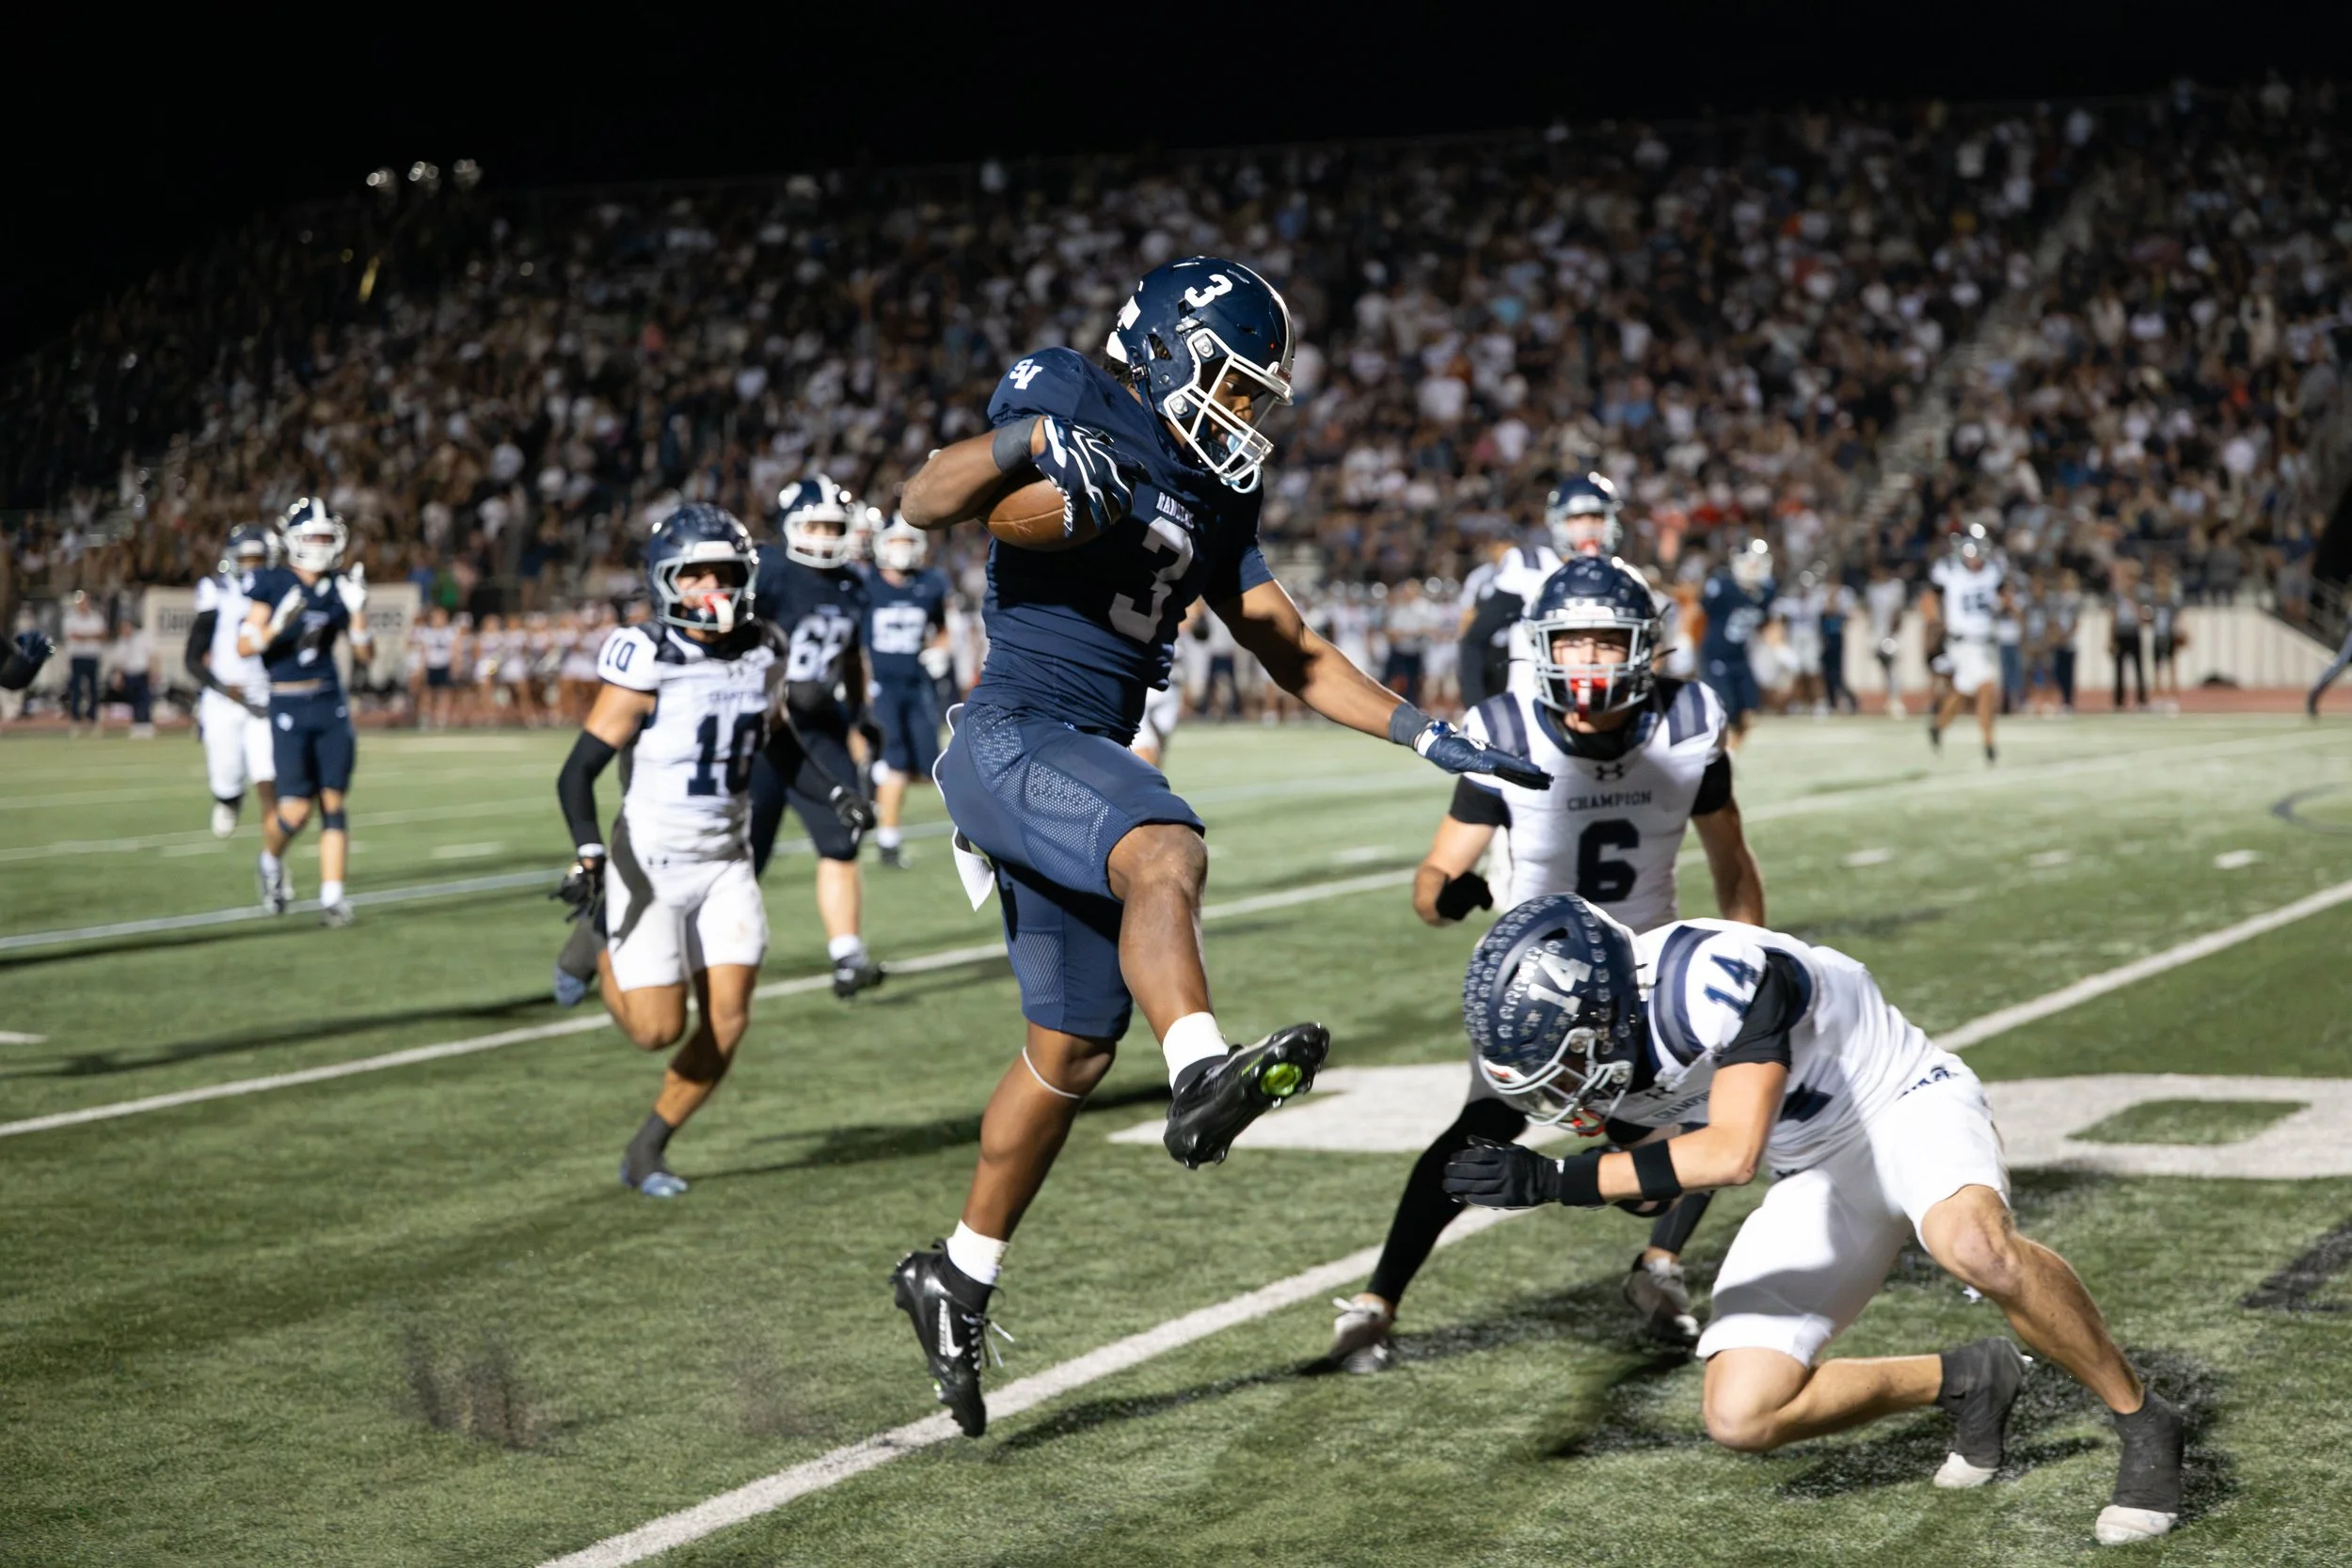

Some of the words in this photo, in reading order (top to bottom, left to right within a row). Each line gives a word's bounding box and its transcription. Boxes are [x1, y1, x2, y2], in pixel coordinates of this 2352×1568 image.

[1184, 274, 1233, 308] 3
[1108, 515, 1195, 645] 3
[606, 638, 637, 673] 10
[688, 712, 763, 796] 10
[1567, 789, 1653, 812] CHAMPION
[1575, 817, 1640, 903] 6
[1527, 951, 1595, 1017] 14
[1703, 953, 1758, 1020] 14
